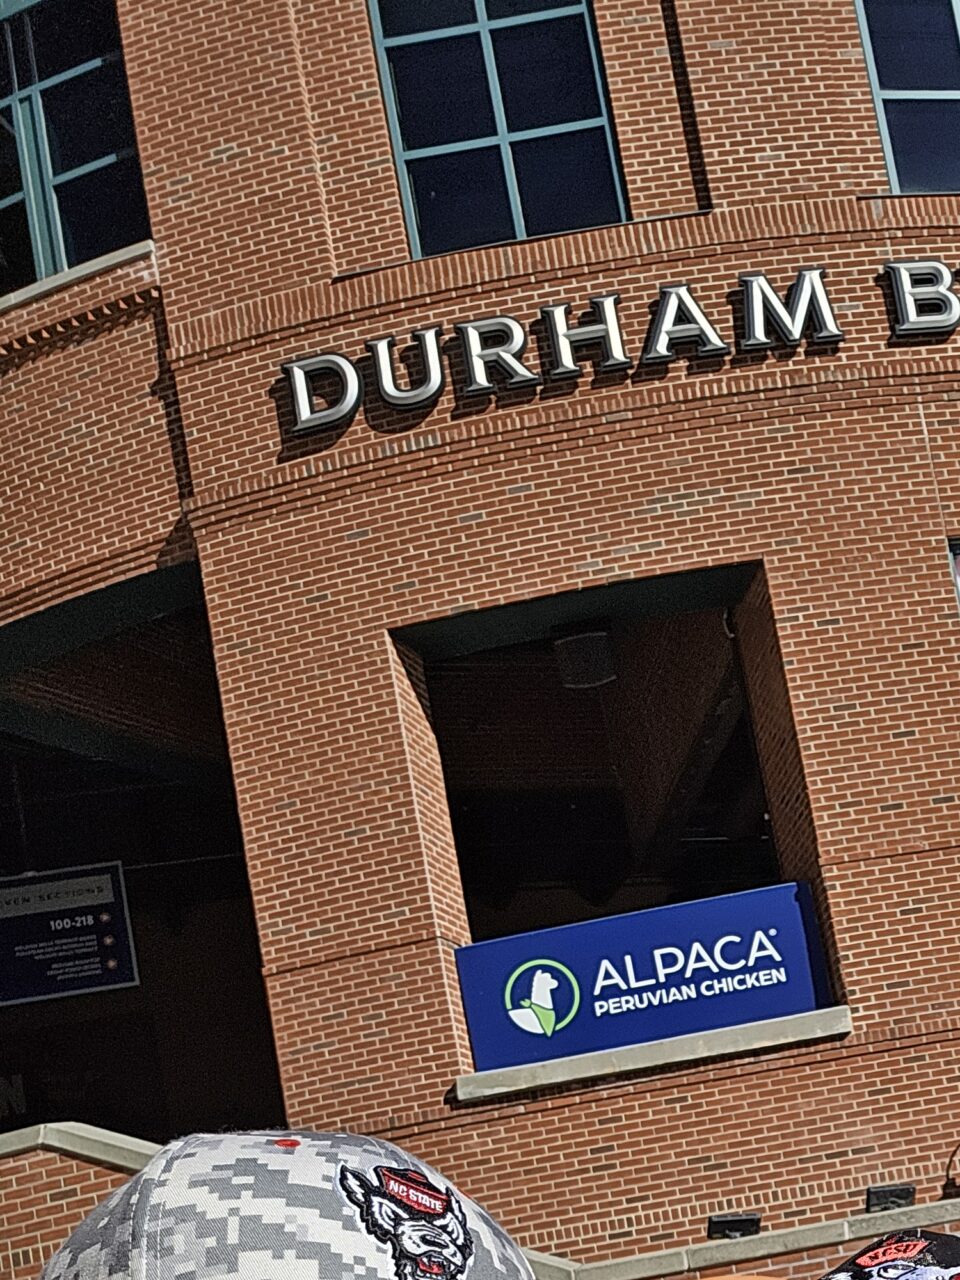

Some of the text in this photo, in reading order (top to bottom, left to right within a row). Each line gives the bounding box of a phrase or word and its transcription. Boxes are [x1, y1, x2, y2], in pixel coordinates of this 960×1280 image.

[280, 266, 845, 436] DURHAM
[49, 915, 95, 932] 100-218
[593, 929, 783, 996] ALPACA
[593, 966, 788, 1018] PERUVIAN CHICKEN
[388, 1180, 444, 1213] NC STATE
[867, 1242, 919, 1262] NCSU
